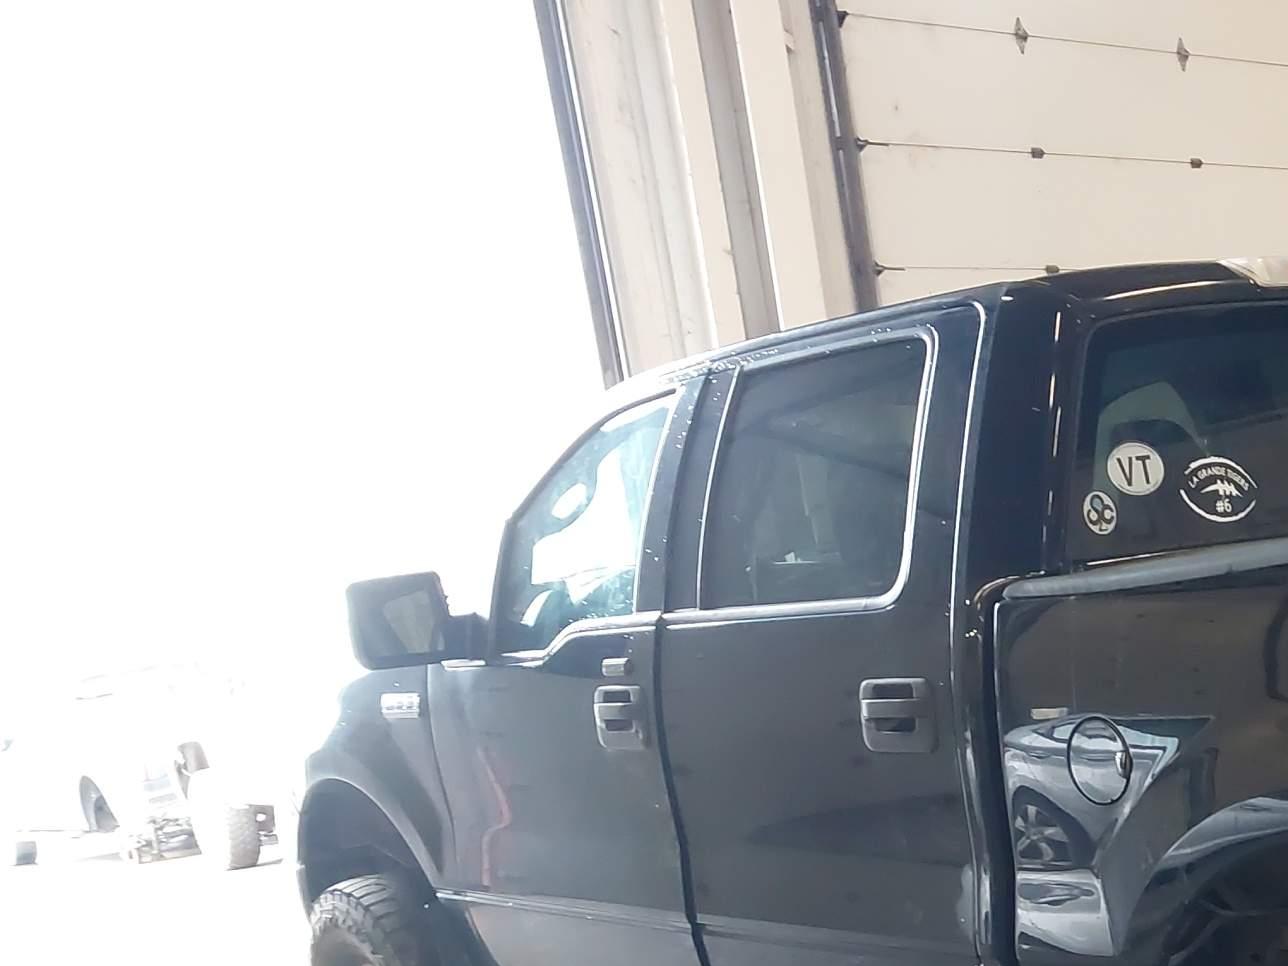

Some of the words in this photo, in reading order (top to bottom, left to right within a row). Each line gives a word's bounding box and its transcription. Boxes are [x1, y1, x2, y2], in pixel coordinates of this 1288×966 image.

[1116, 454, 1151, 487] VT
[1187, 475, 1200, 489] LA
[1196, 466, 1226, 480] GRANDE
[1215, 498, 1233, 513] #6
